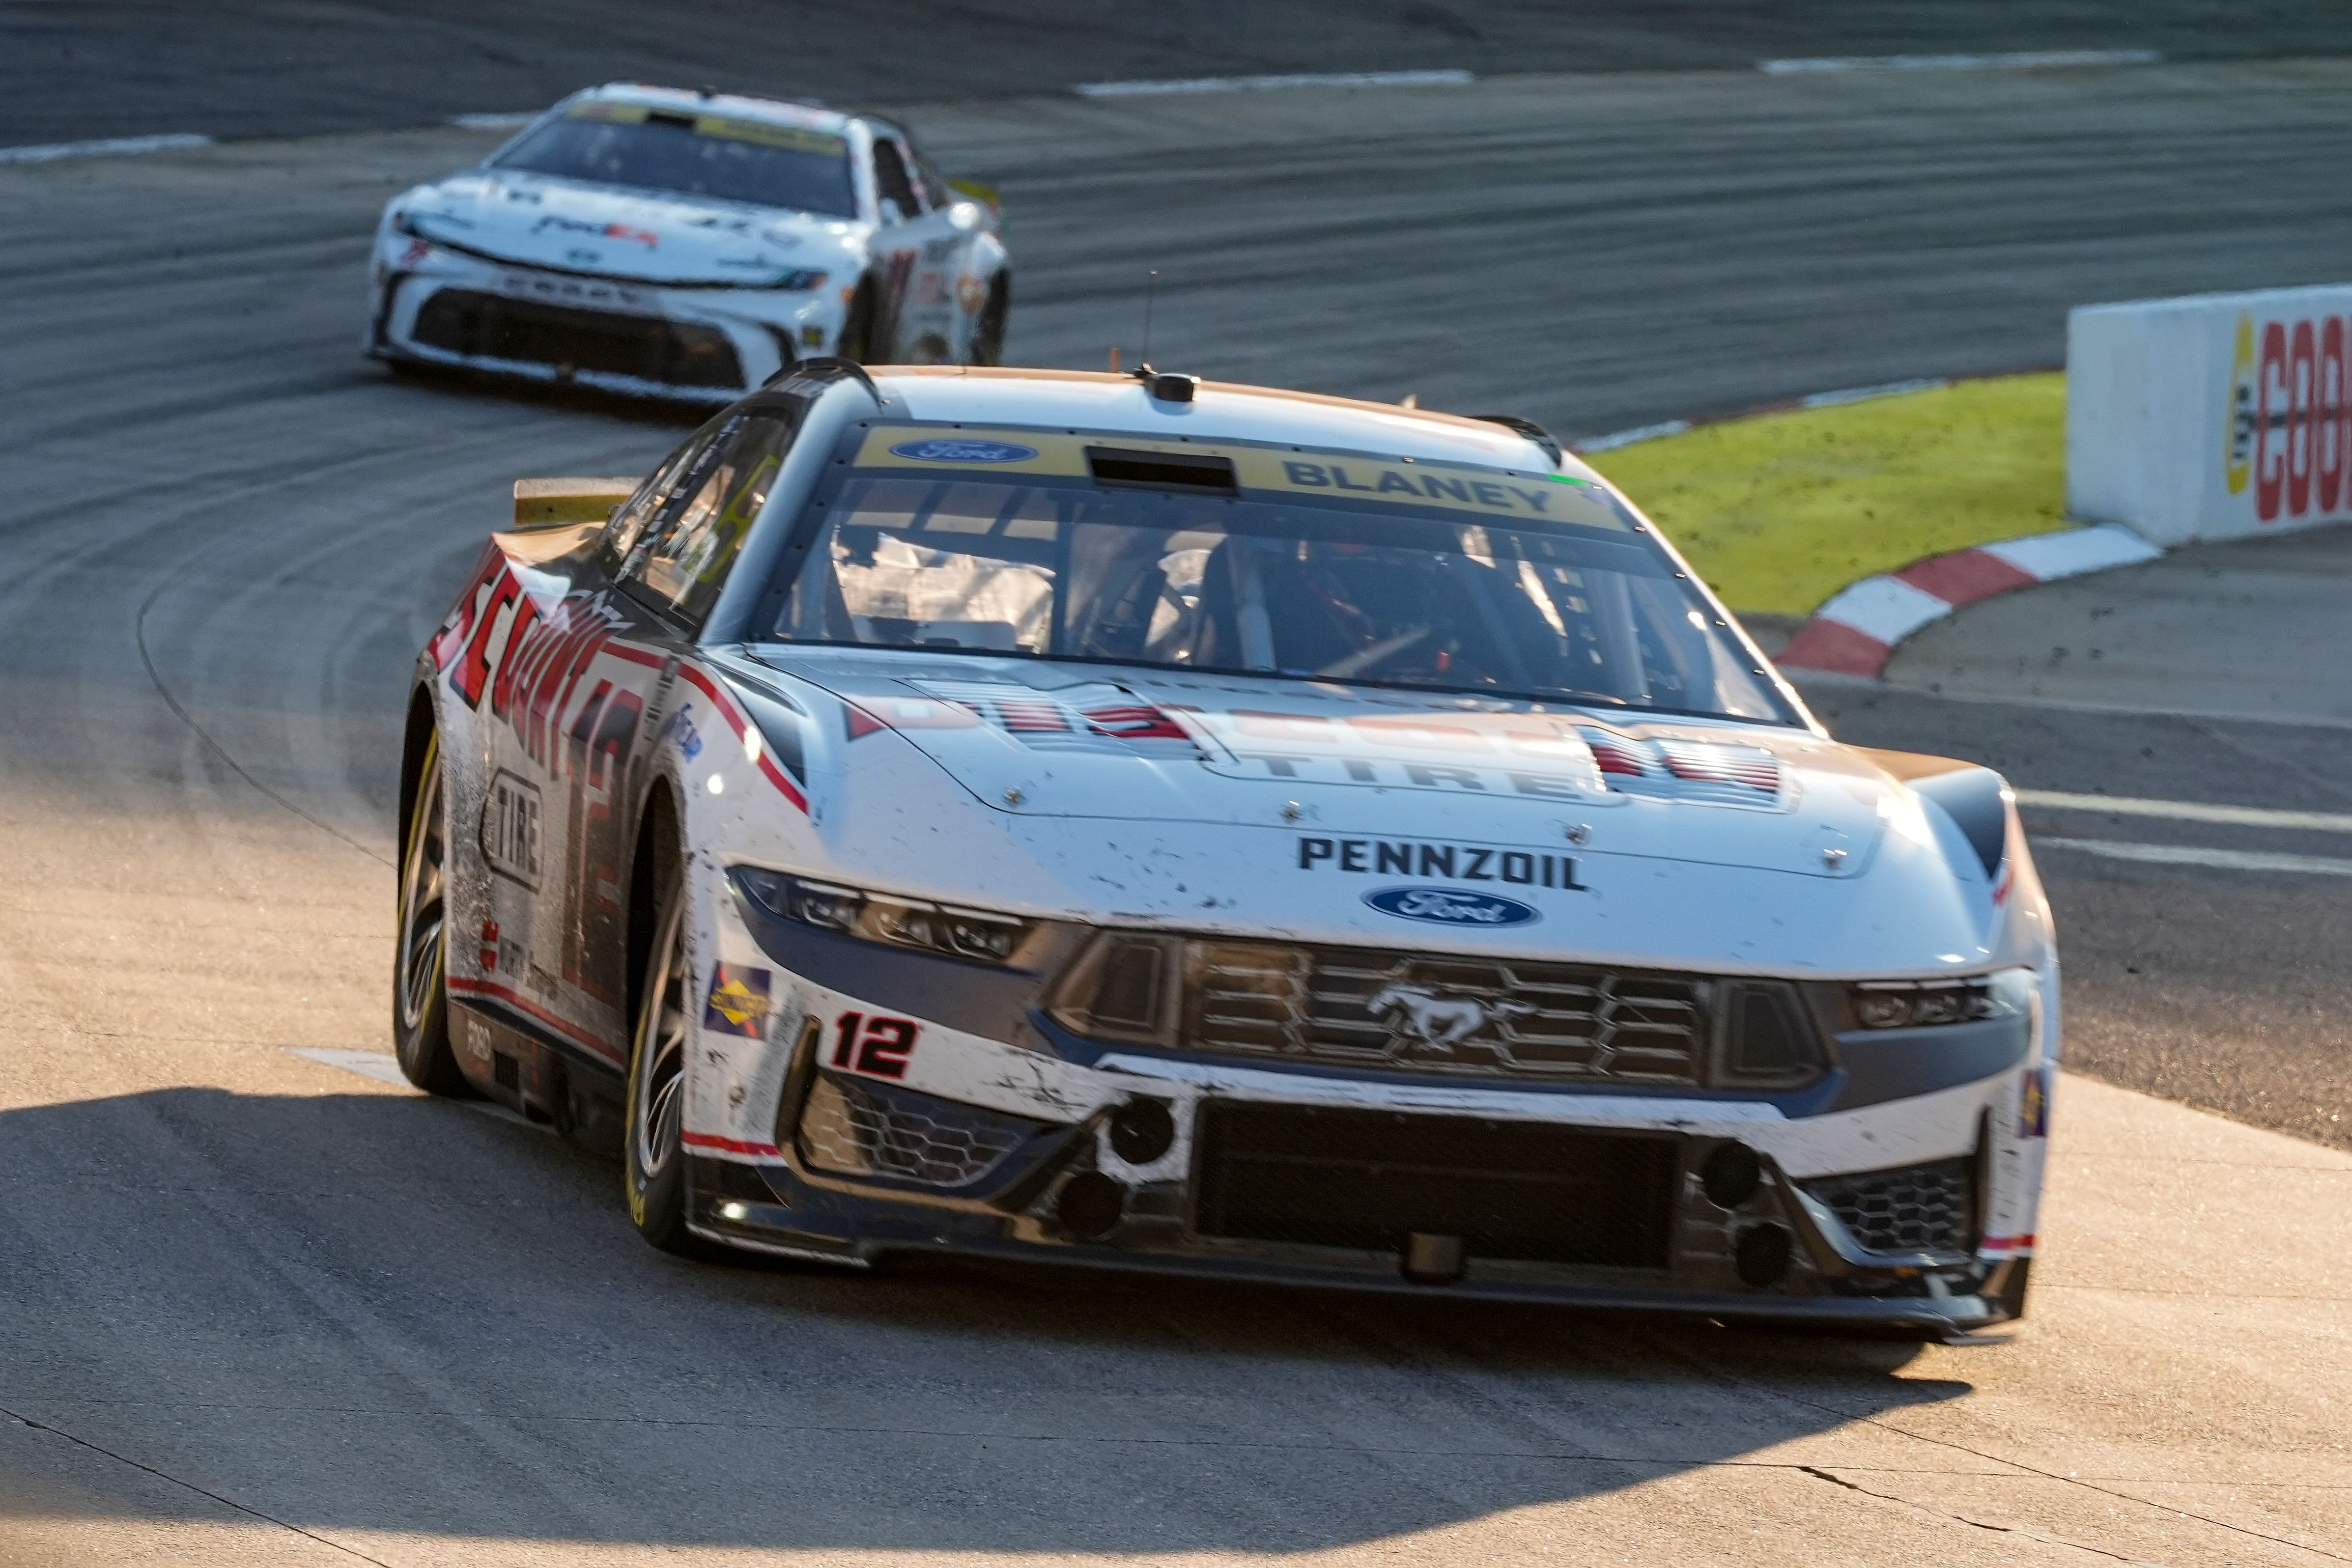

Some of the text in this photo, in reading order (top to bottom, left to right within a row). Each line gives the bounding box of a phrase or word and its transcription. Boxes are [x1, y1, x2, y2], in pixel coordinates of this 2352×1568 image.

[2256, 315, 2352, 521] COO
[917, 441, 1010, 460] Ford
[1284, 461, 1549, 512] BLANEY
[1239, 752, 1586, 800] TIRE
[497, 784, 538, 875] TIRE
[1300, 837, 1589, 891] PENNZOIL
[1397, 891, 1506, 923] Ford
[831, 1011, 918, 1081] 12
